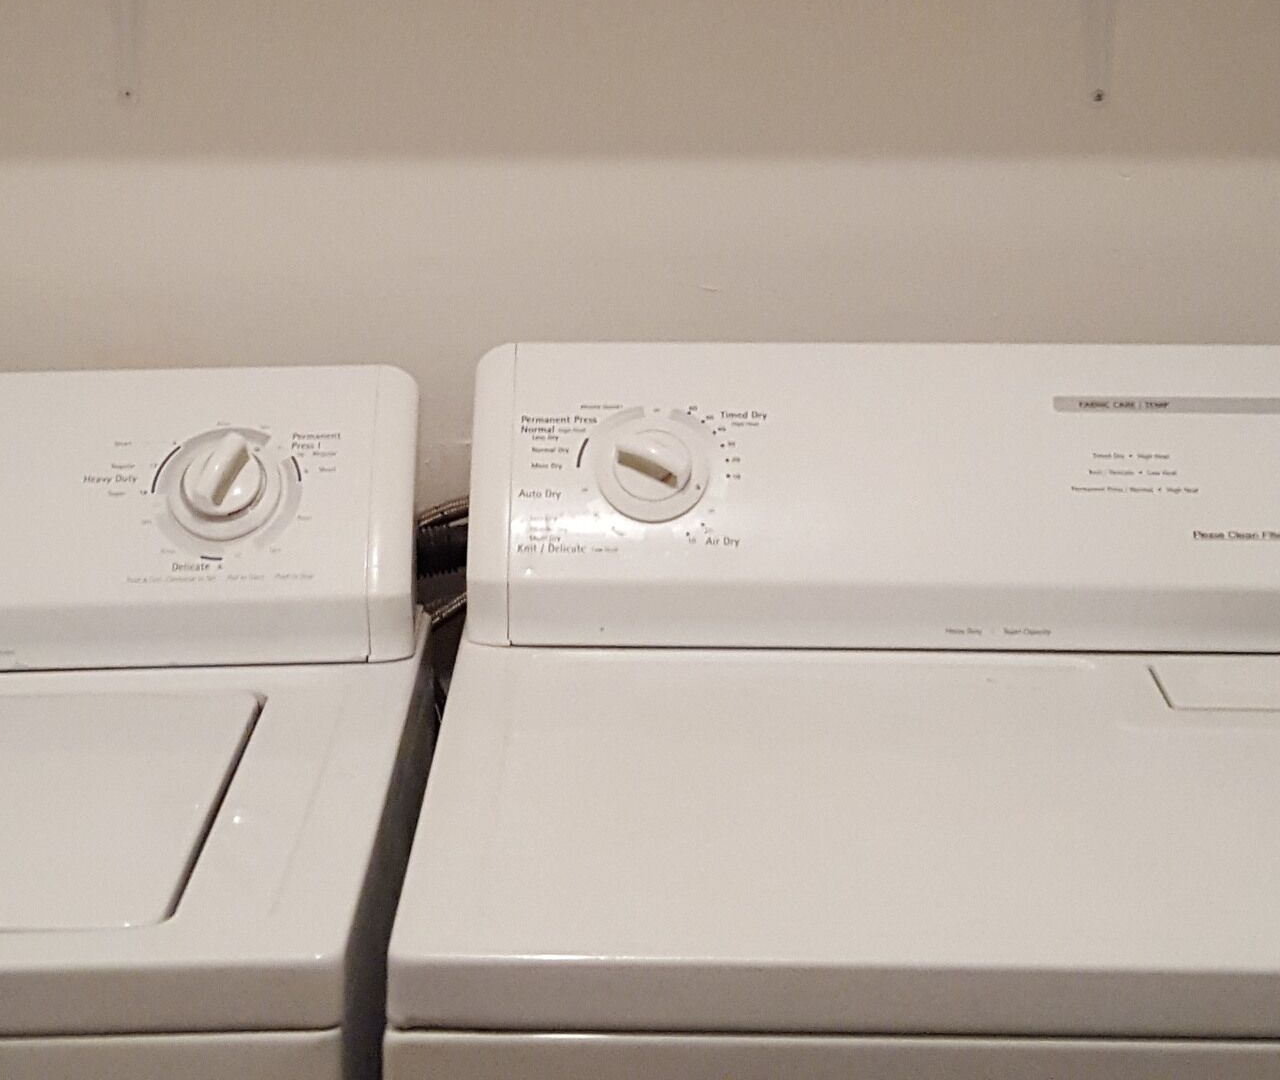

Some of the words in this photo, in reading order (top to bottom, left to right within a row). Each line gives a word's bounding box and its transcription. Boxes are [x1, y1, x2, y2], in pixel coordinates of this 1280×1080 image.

[521, 414, 569, 423] Permanent
[574, 415, 597, 424] Press
[721, 410, 748, 419] Timed
[752, 410, 768, 421] Dry
[520, 424, 555, 433] Normal
[292, 431, 341, 440] Permanent
[291, 441, 314, 449] Press
[83, 475, 112, 484] Heavy
[115, 474, 138, 483] Duty
[518, 488, 542, 498] Auto
[545, 488, 562, 500] Dry
[705, 536, 721, 545] Air
[723, 536, 741, 547] Dry
[517, 543, 538, 553] Knit
[548, 543, 586, 554] Delicate
[171, 562, 211, 571] Delicate
